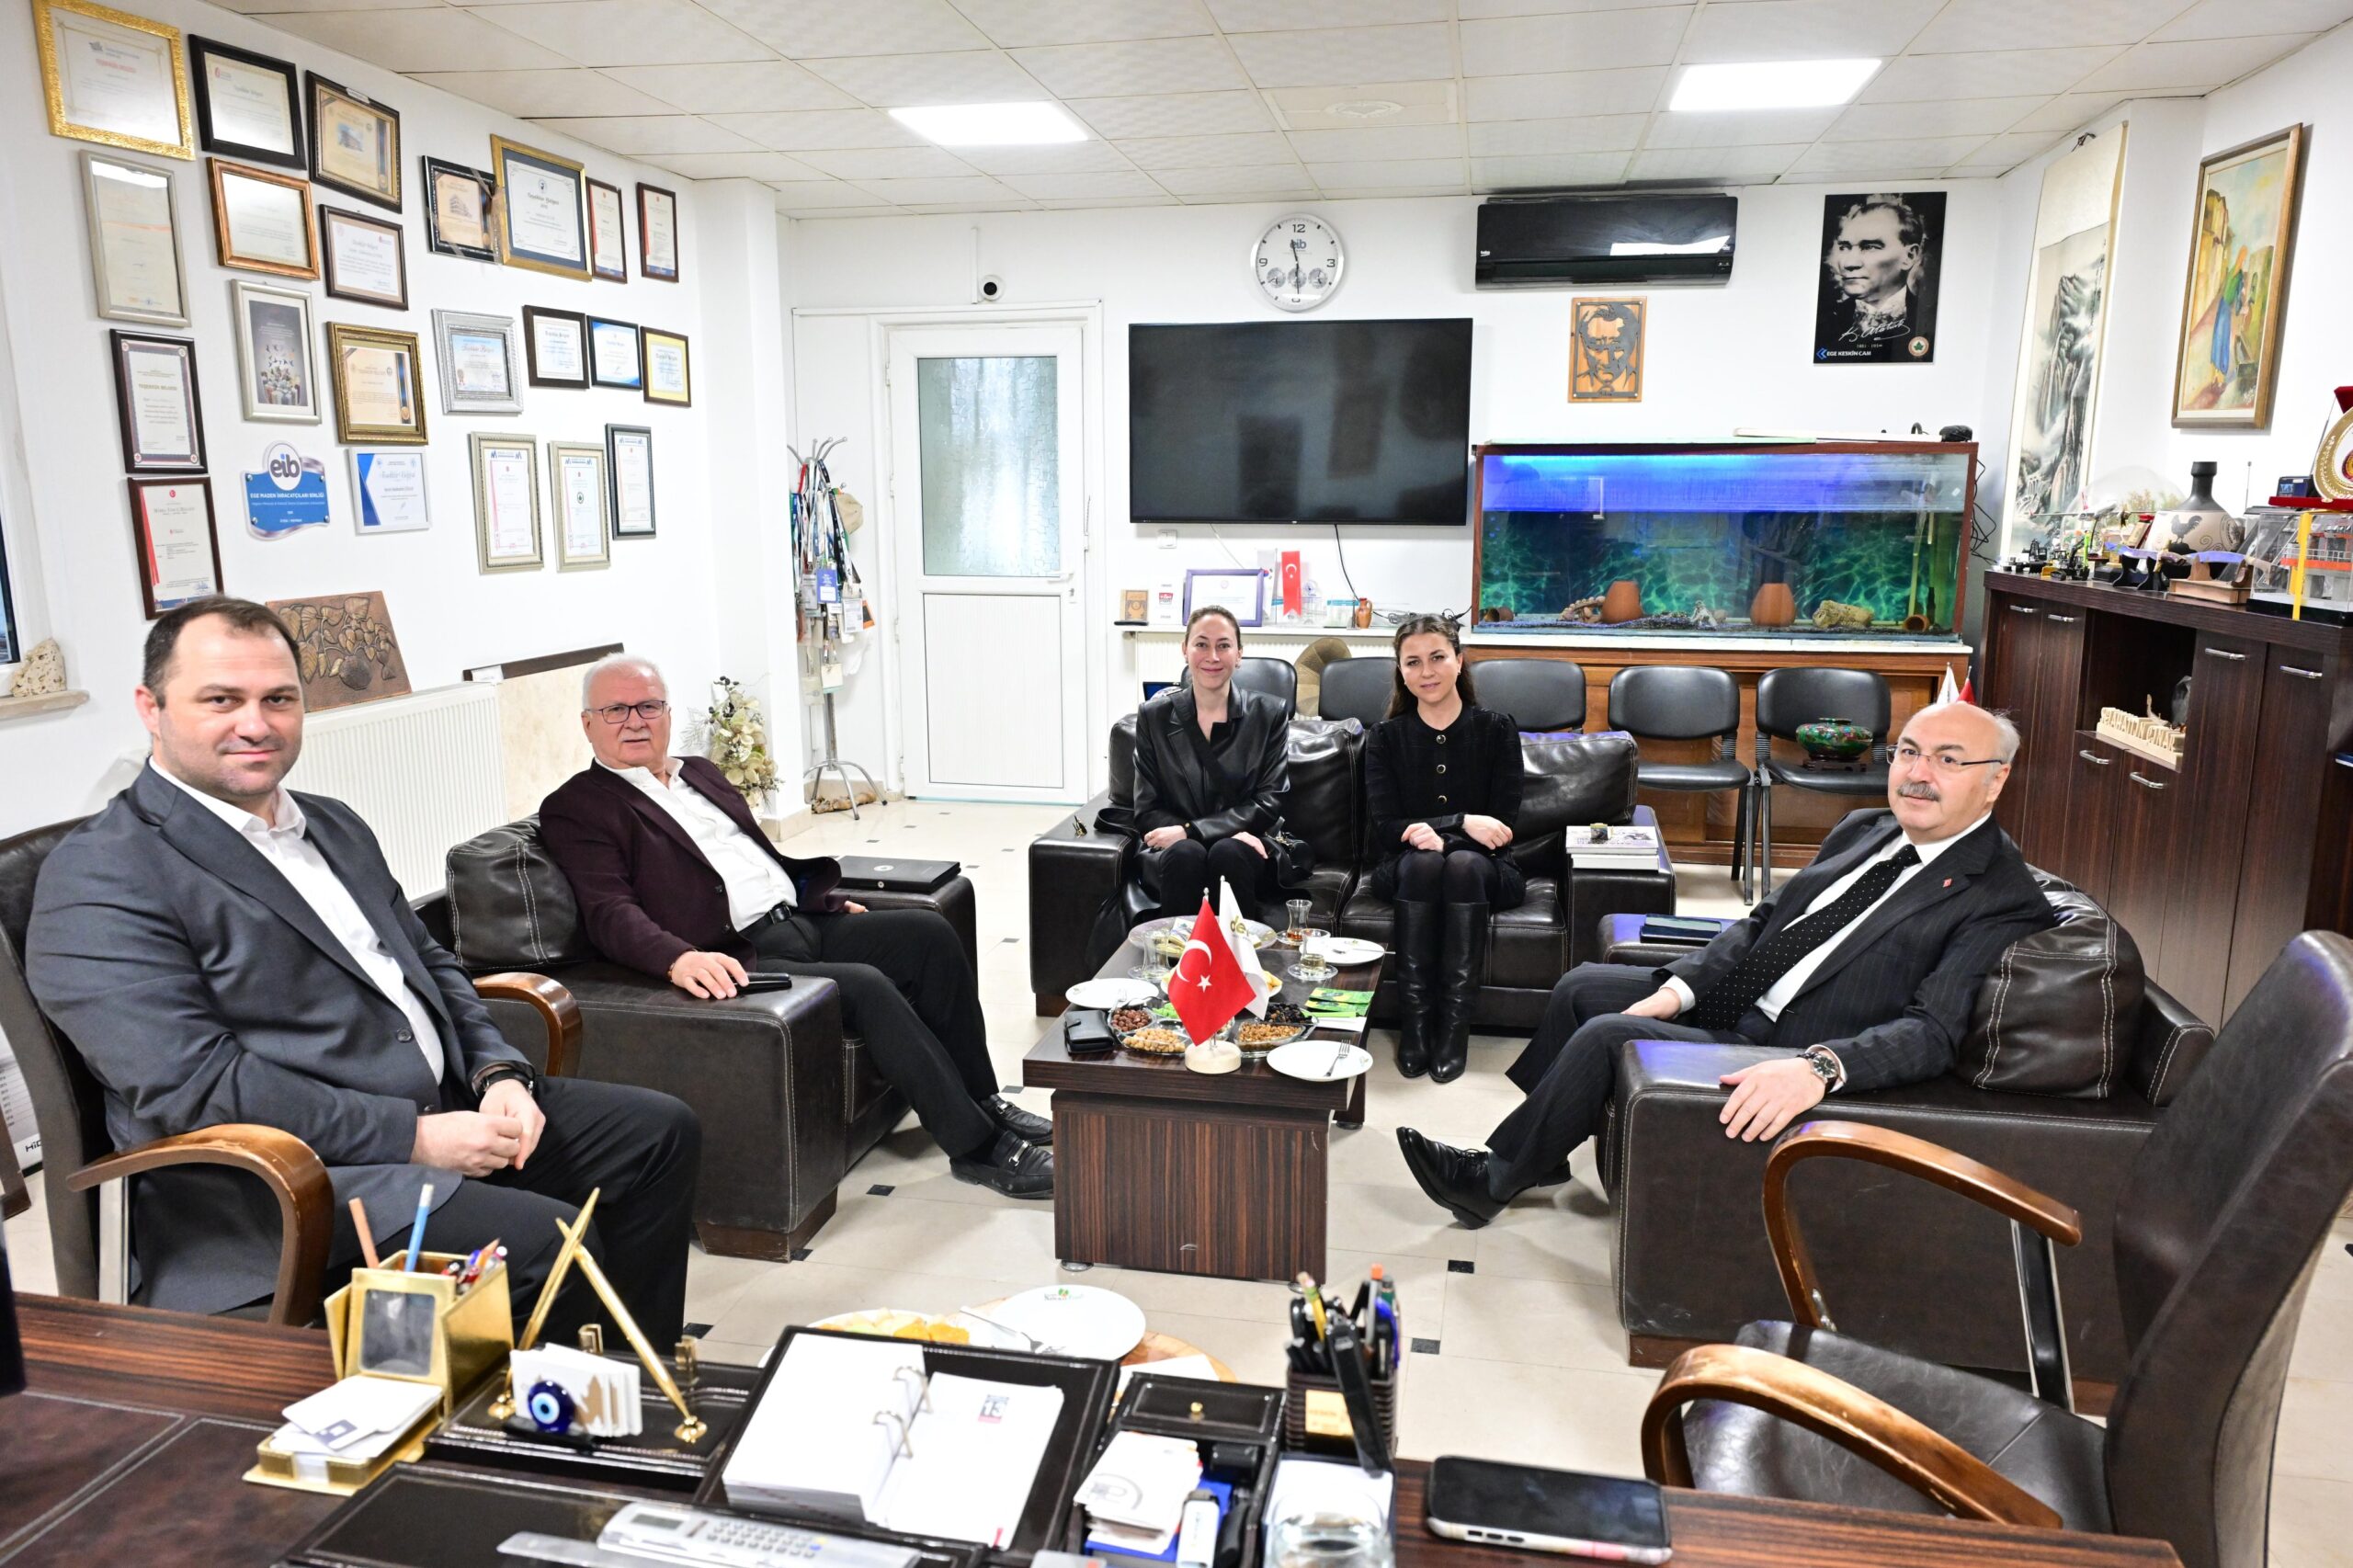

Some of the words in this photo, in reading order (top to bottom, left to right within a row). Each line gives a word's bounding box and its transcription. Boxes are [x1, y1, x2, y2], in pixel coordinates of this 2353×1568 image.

[1292, 224, 1306, 233] 12
[1258, 257, 1268, 267] 9
[1326, 258, 1336, 267] 3
[269, 453, 300, 478] eib
[983, 1402, 1006, 1417] 13
